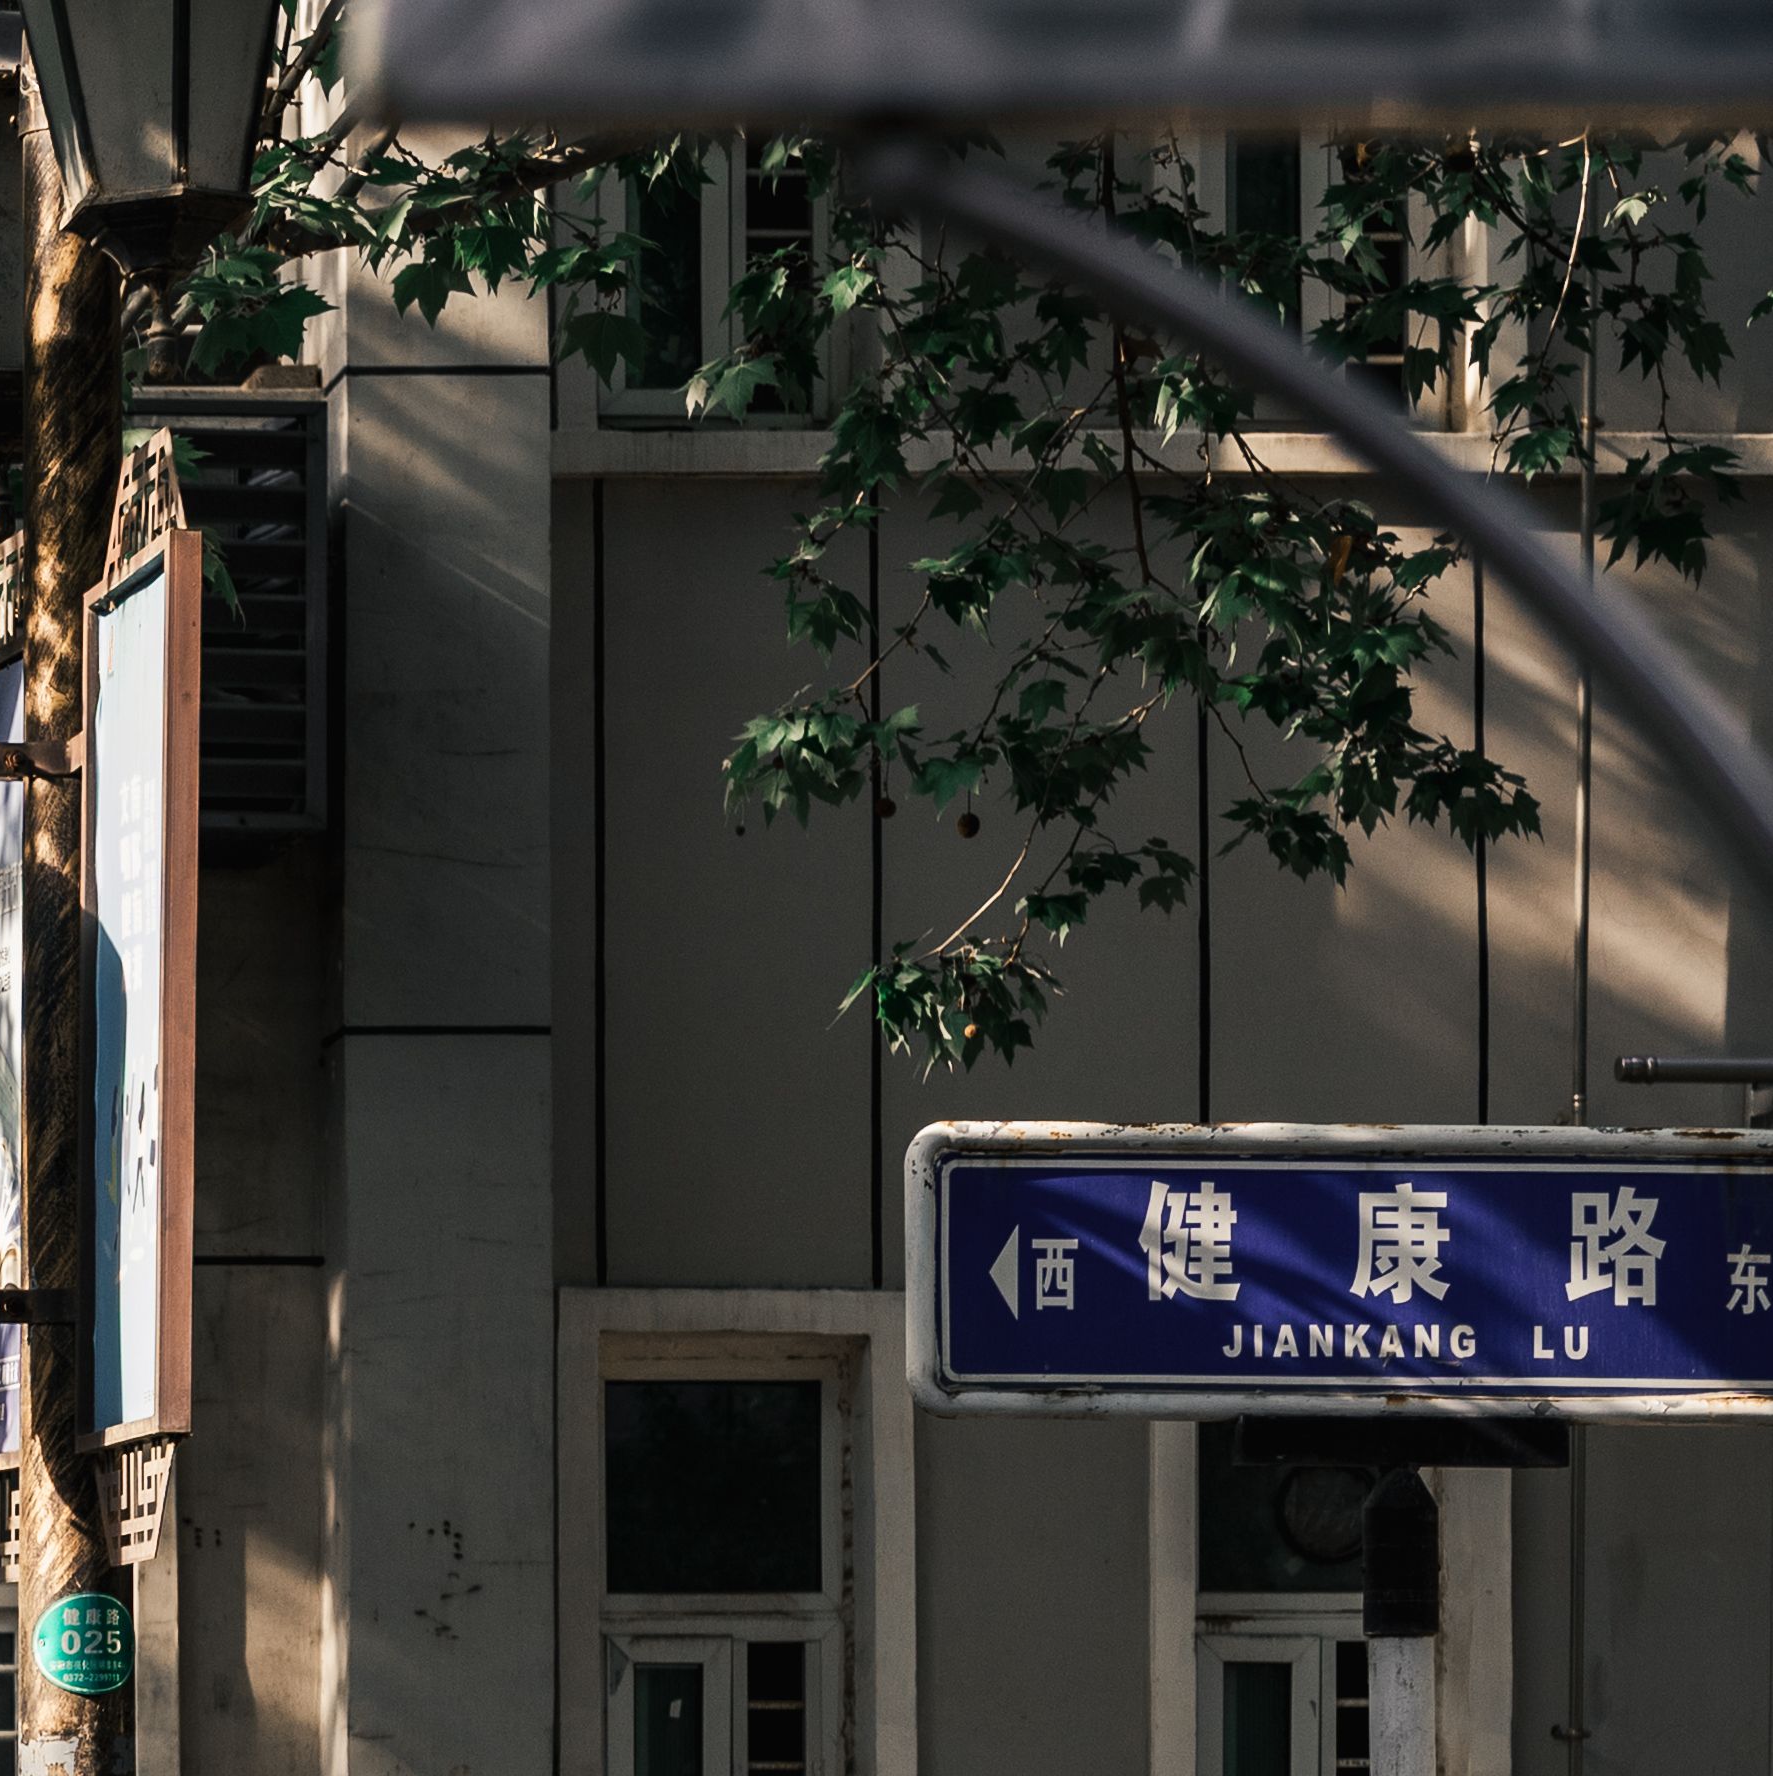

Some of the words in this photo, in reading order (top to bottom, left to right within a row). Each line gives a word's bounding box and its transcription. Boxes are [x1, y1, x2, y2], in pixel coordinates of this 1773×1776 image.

[1138, 1180, 1667, 1307] 健康路
[1031, 1238, 1079, 1311] 西
[1726, 1244, 1772, 1315] 东
[1222, 1323, 1476, 1360] JIANKANG
[1533, 1326, 1590, 1361] LU
[60, 1629, 121, 1655] 025
[62, 1607, 120, 1626] 健康路
